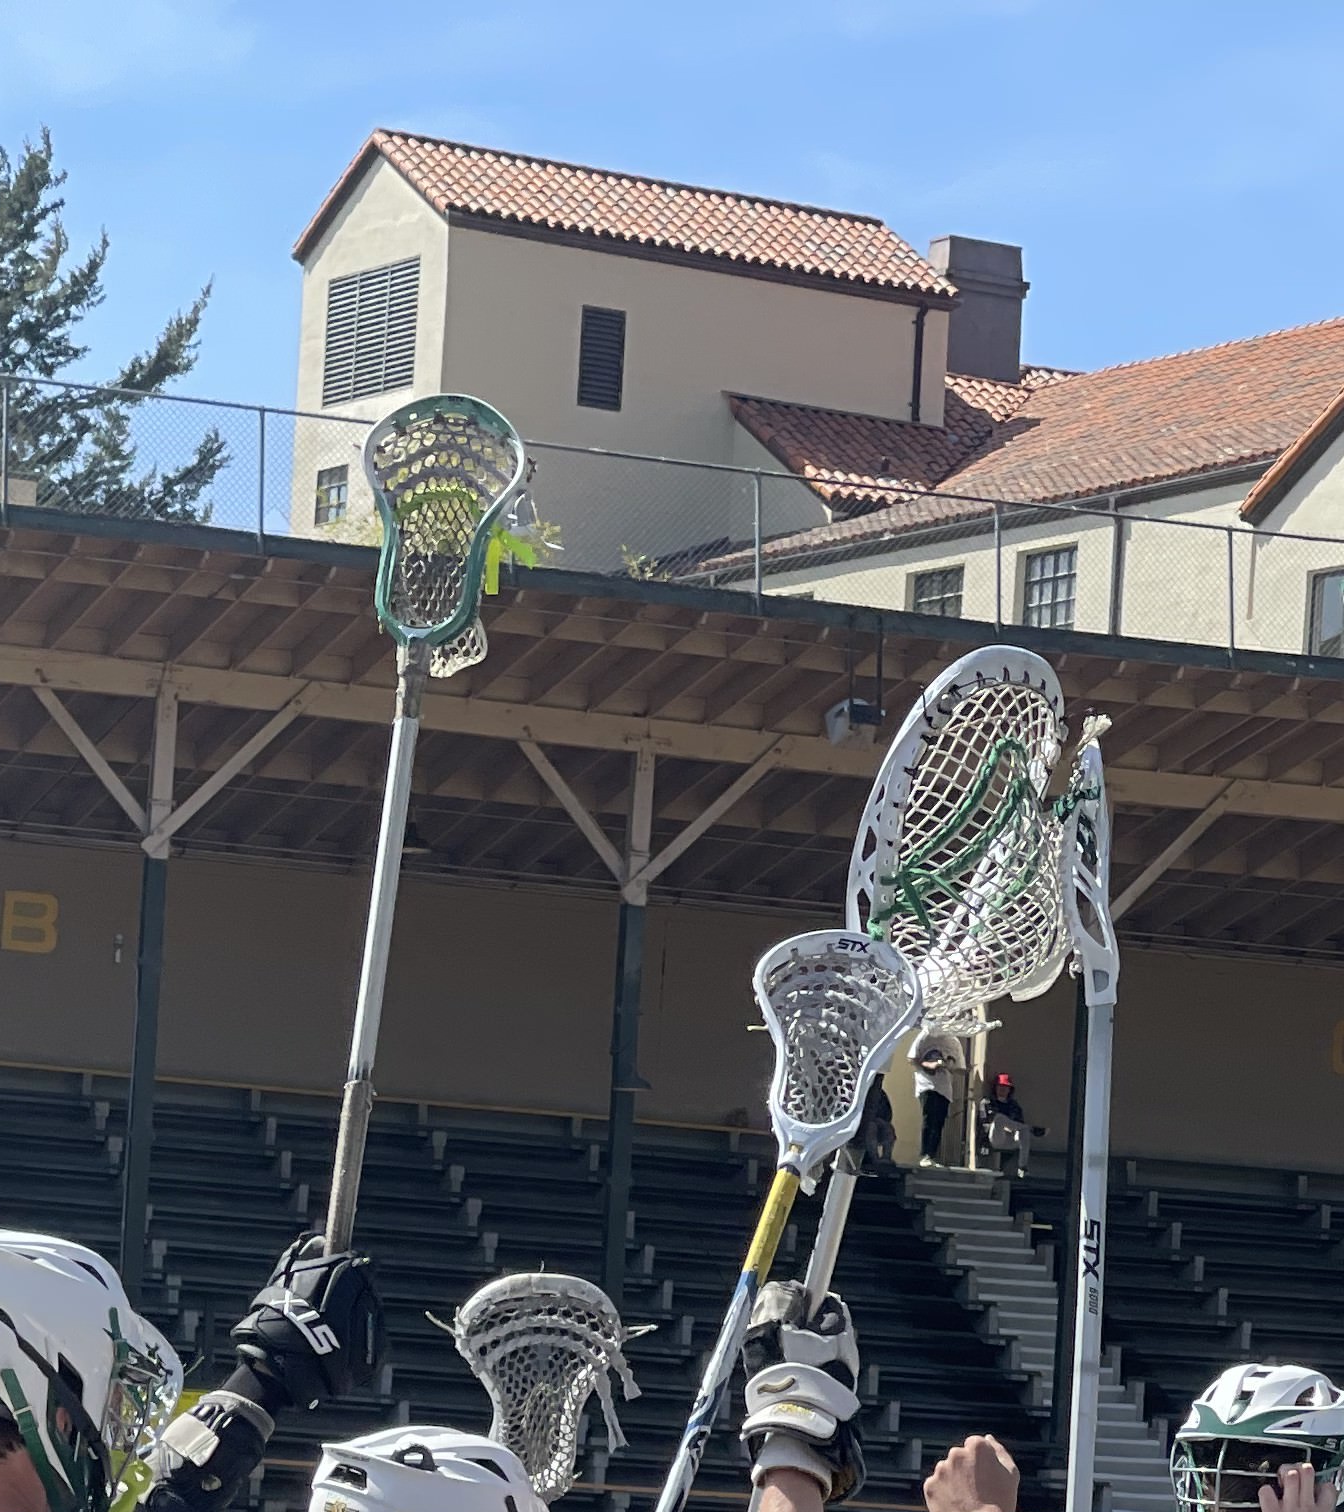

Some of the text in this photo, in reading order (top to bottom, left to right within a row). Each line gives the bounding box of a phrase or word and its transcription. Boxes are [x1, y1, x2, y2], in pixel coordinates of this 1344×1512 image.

[1, 889, 59, 953] B
[836, 938, 870, 954] STX
[1082, 1218, 1101, 1282] STX
[269, 1290, 341, 1355] STX
